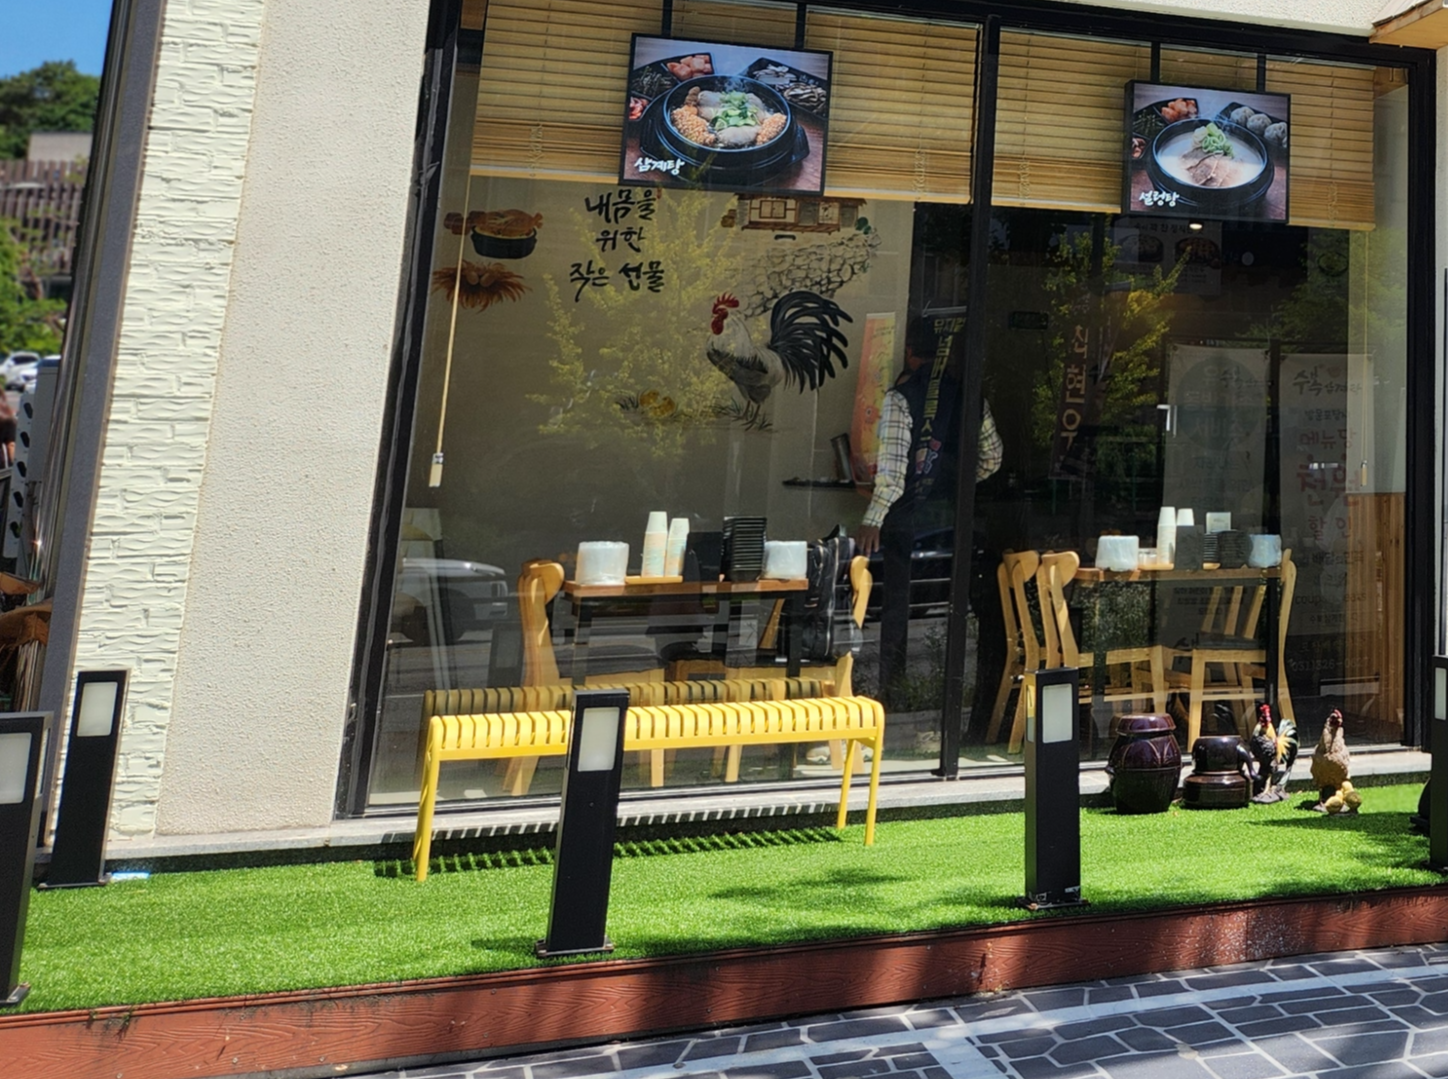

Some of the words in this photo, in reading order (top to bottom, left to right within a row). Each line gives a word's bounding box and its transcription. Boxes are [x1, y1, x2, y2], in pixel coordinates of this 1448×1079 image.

[634, 157, 685, 175] 삼계탕
[584, 188, 658, 224] 내몸을
[1138, 190, 1181, 207] 설렁탕
[596, 227, 645, 253] 위한
[569, 261, 610, 302] 작은
[619, 261, 665, 293] 선물
